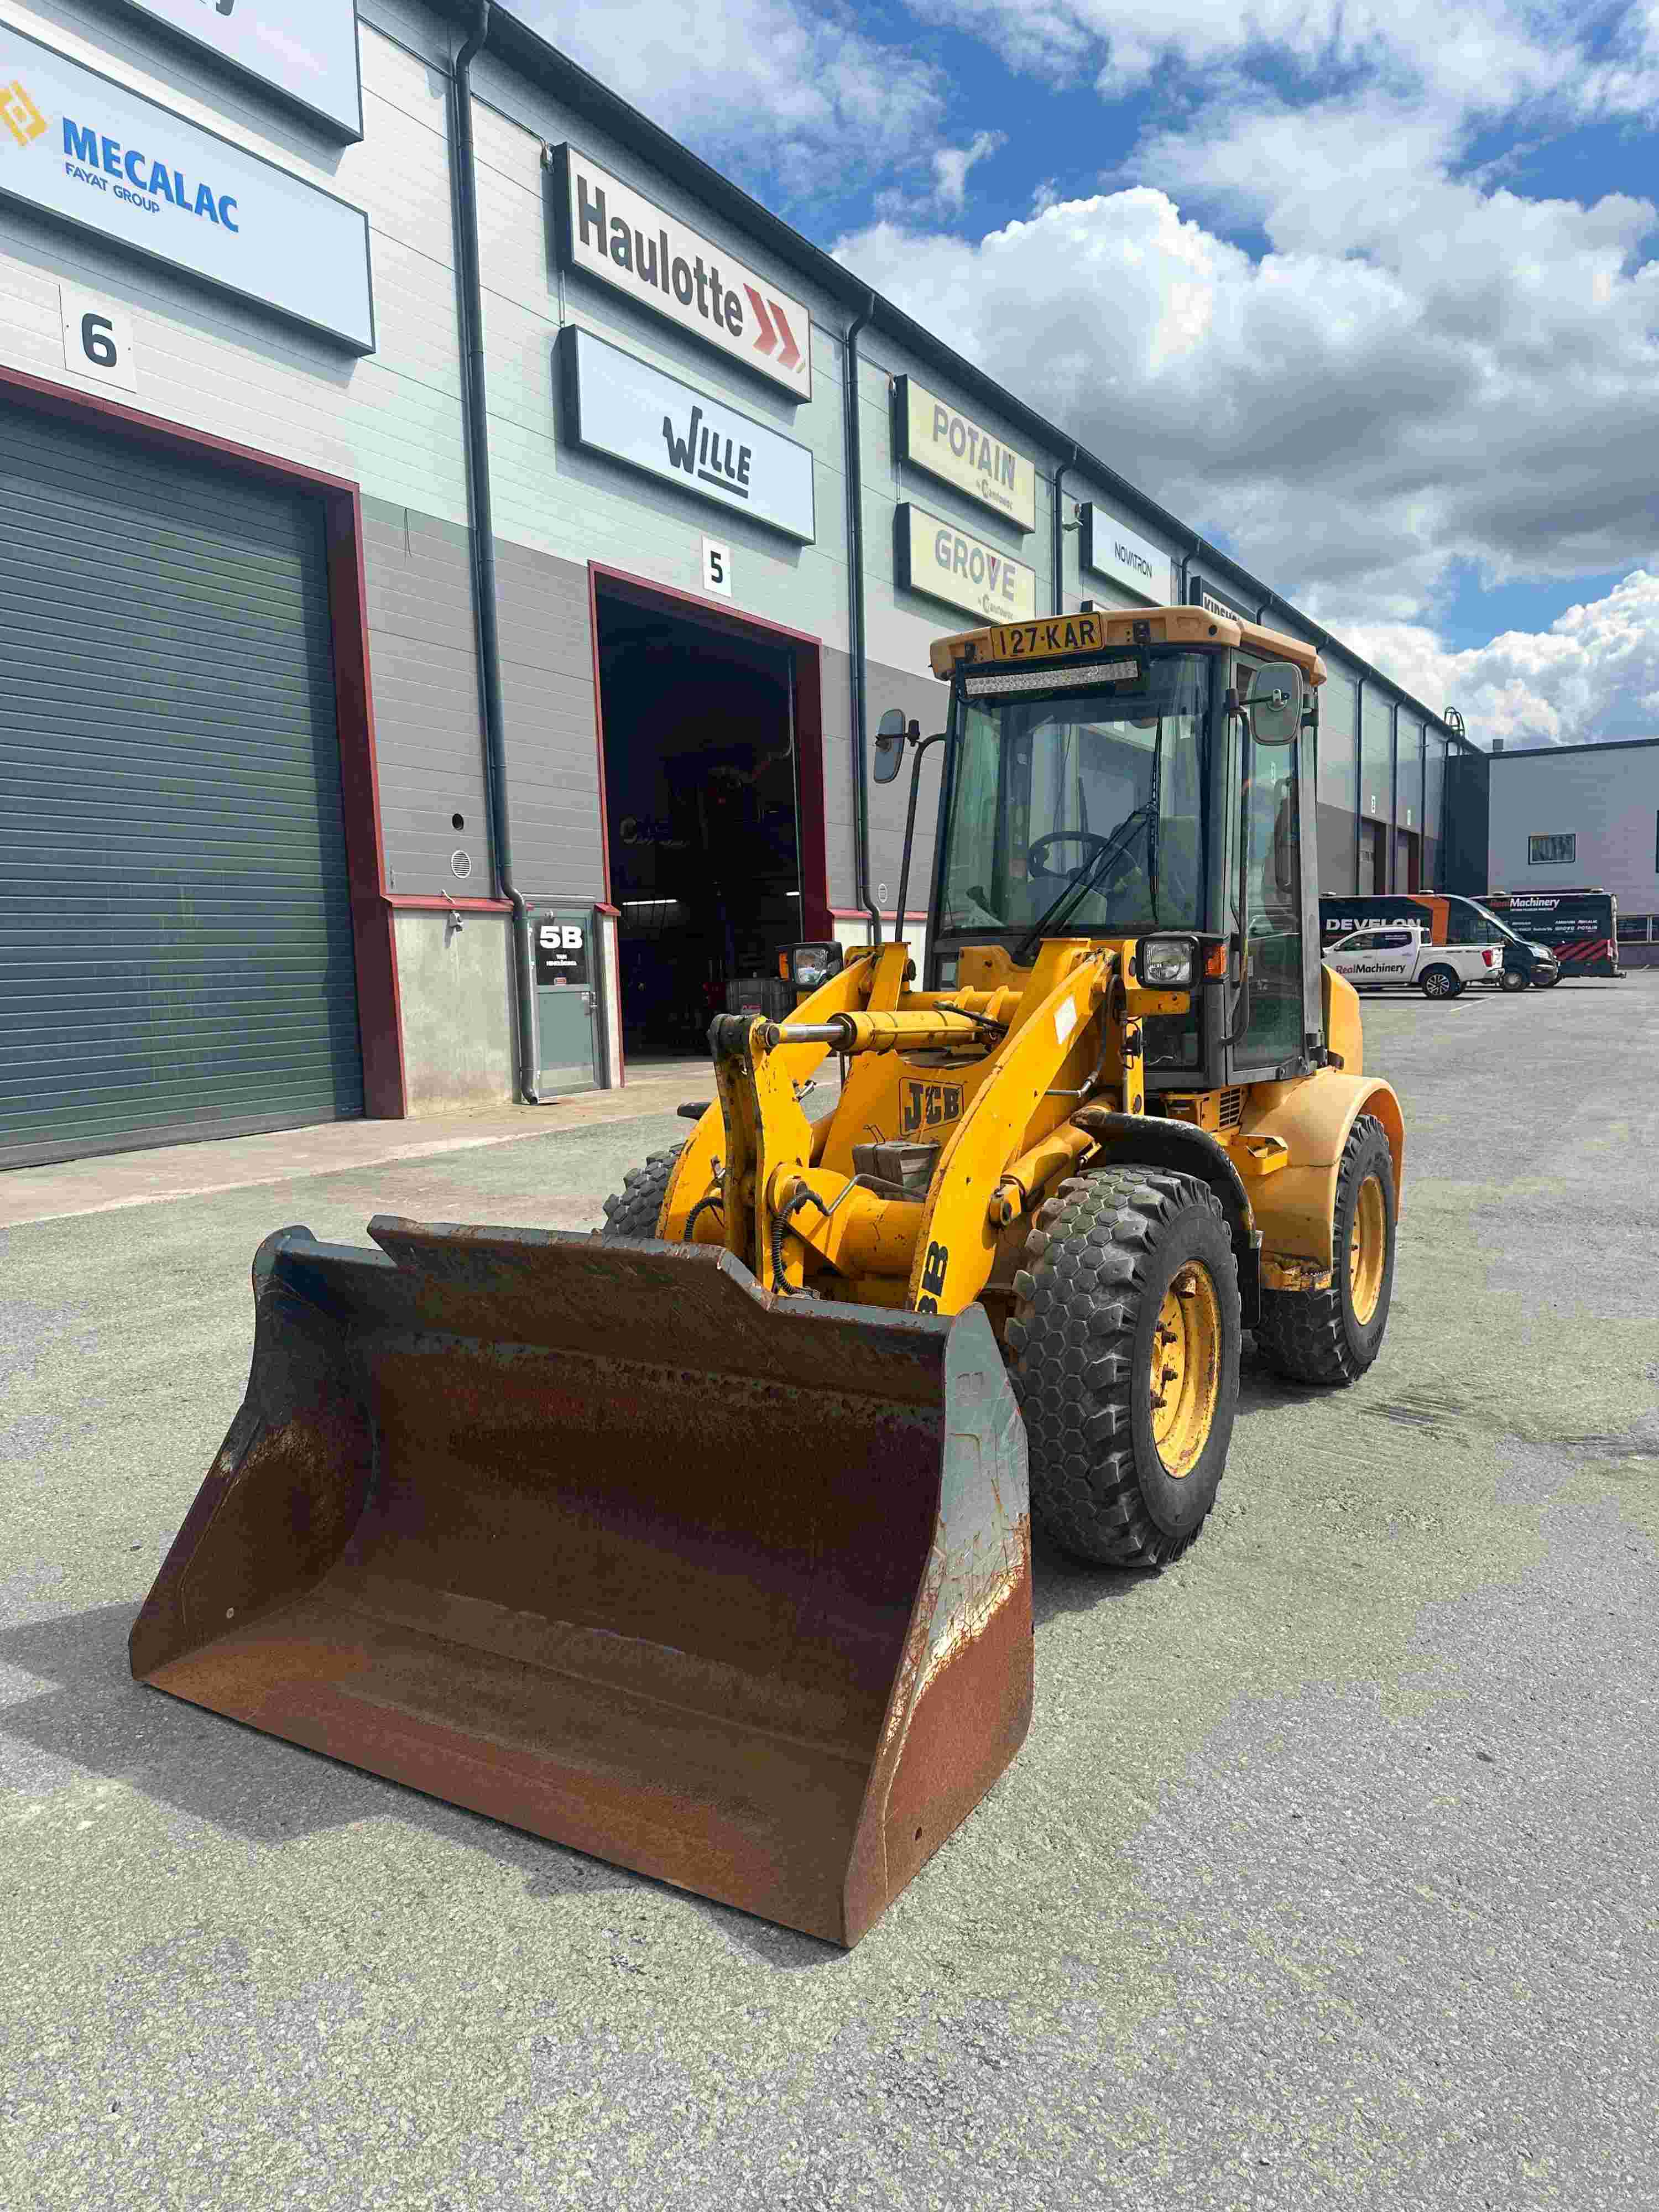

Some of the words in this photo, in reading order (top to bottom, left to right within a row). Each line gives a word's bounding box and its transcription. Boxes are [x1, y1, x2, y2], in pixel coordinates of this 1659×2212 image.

[62, 117, 239, 233] MECALAC
[65, 163, 108, 192] FAYAT
[113, 184, 161, 214] GROUP
[577, 174, 743, 337] Haulotte
[81, 313, 117, 368] 6
[933, 404, 1015, 491] POTAIN
[709, 550, 723, 583] 5
[935, 529, 1016, 602] GROVE
[1114, 540, 1153, 578] NOVATRON
[540, 926, 582, 949] 5B
[1336, 963, 1406, 974] RealMachinery
[905, 1082, 959, 1131] JCB
